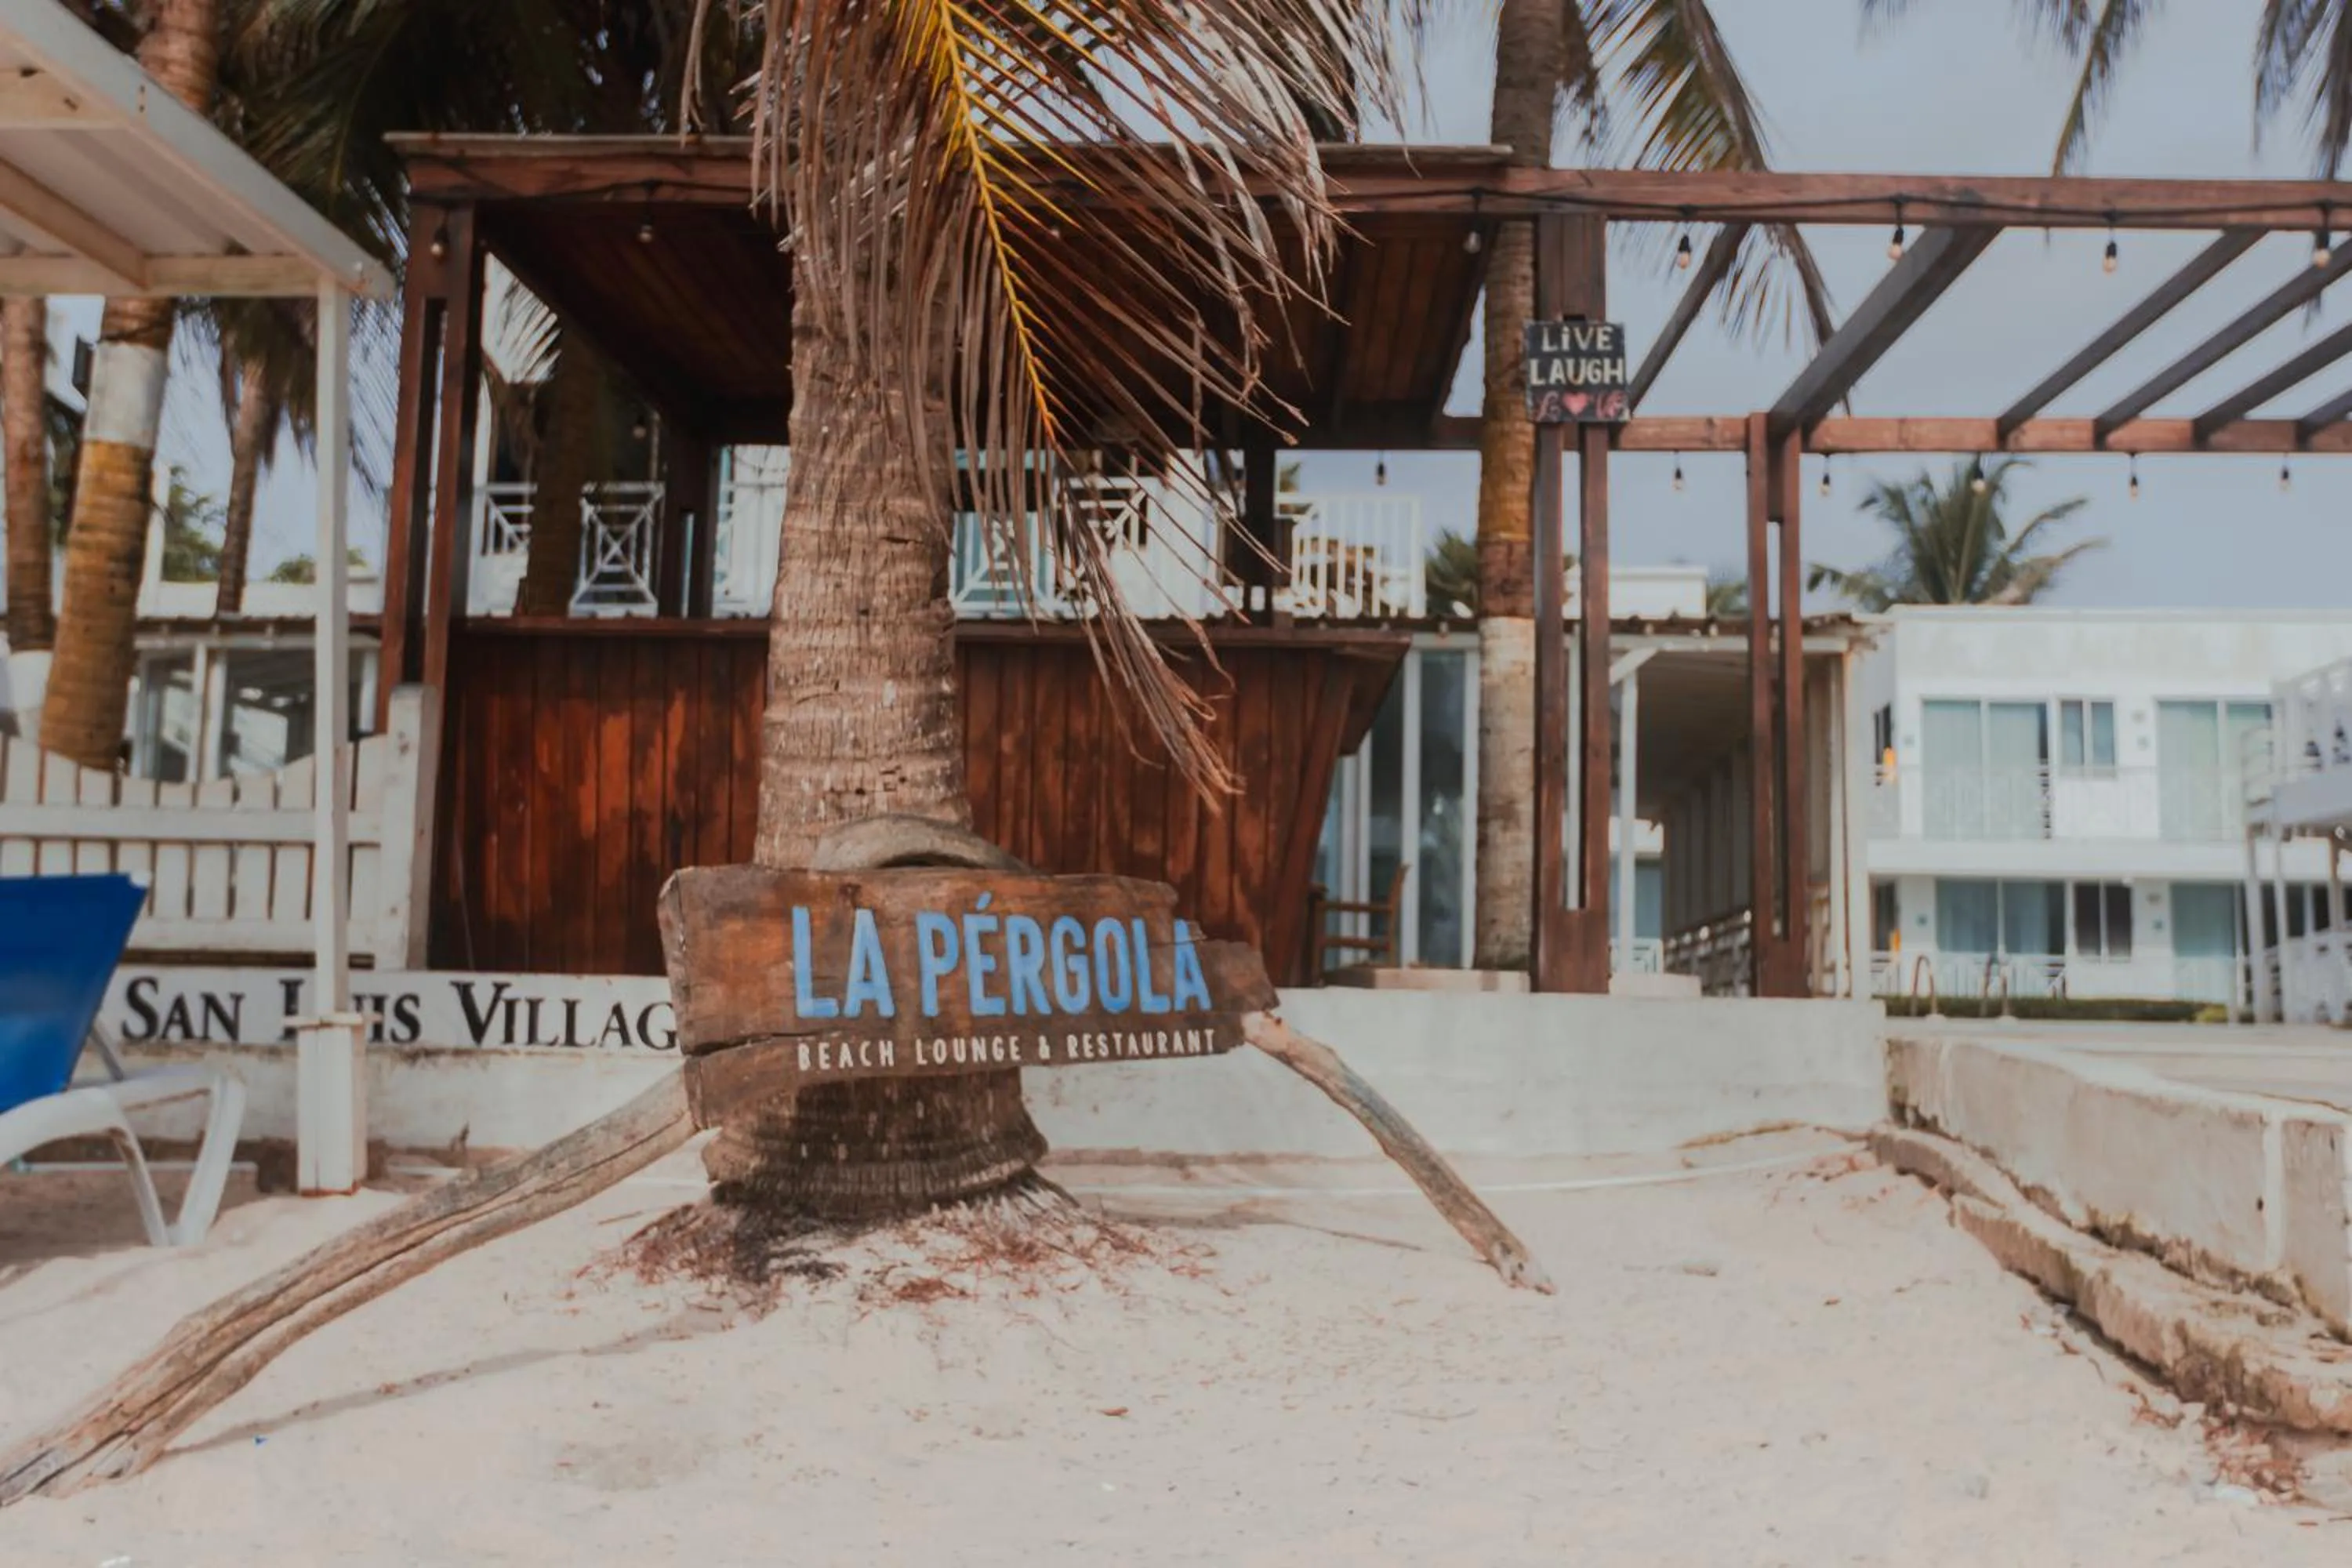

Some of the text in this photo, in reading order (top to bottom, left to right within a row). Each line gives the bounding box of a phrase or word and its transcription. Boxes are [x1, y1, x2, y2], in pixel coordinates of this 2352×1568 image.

[1530, 358, 1624, 385] LAUGH
[791, 891, 1212, 1018] LA PÉRGOLA
[122, 976, 245, 1041] SAN
[278, 978, 421, 1044] LIS
[797, 1028, 1216, 1071] BEACH LOUNGE & RESTAURANT
